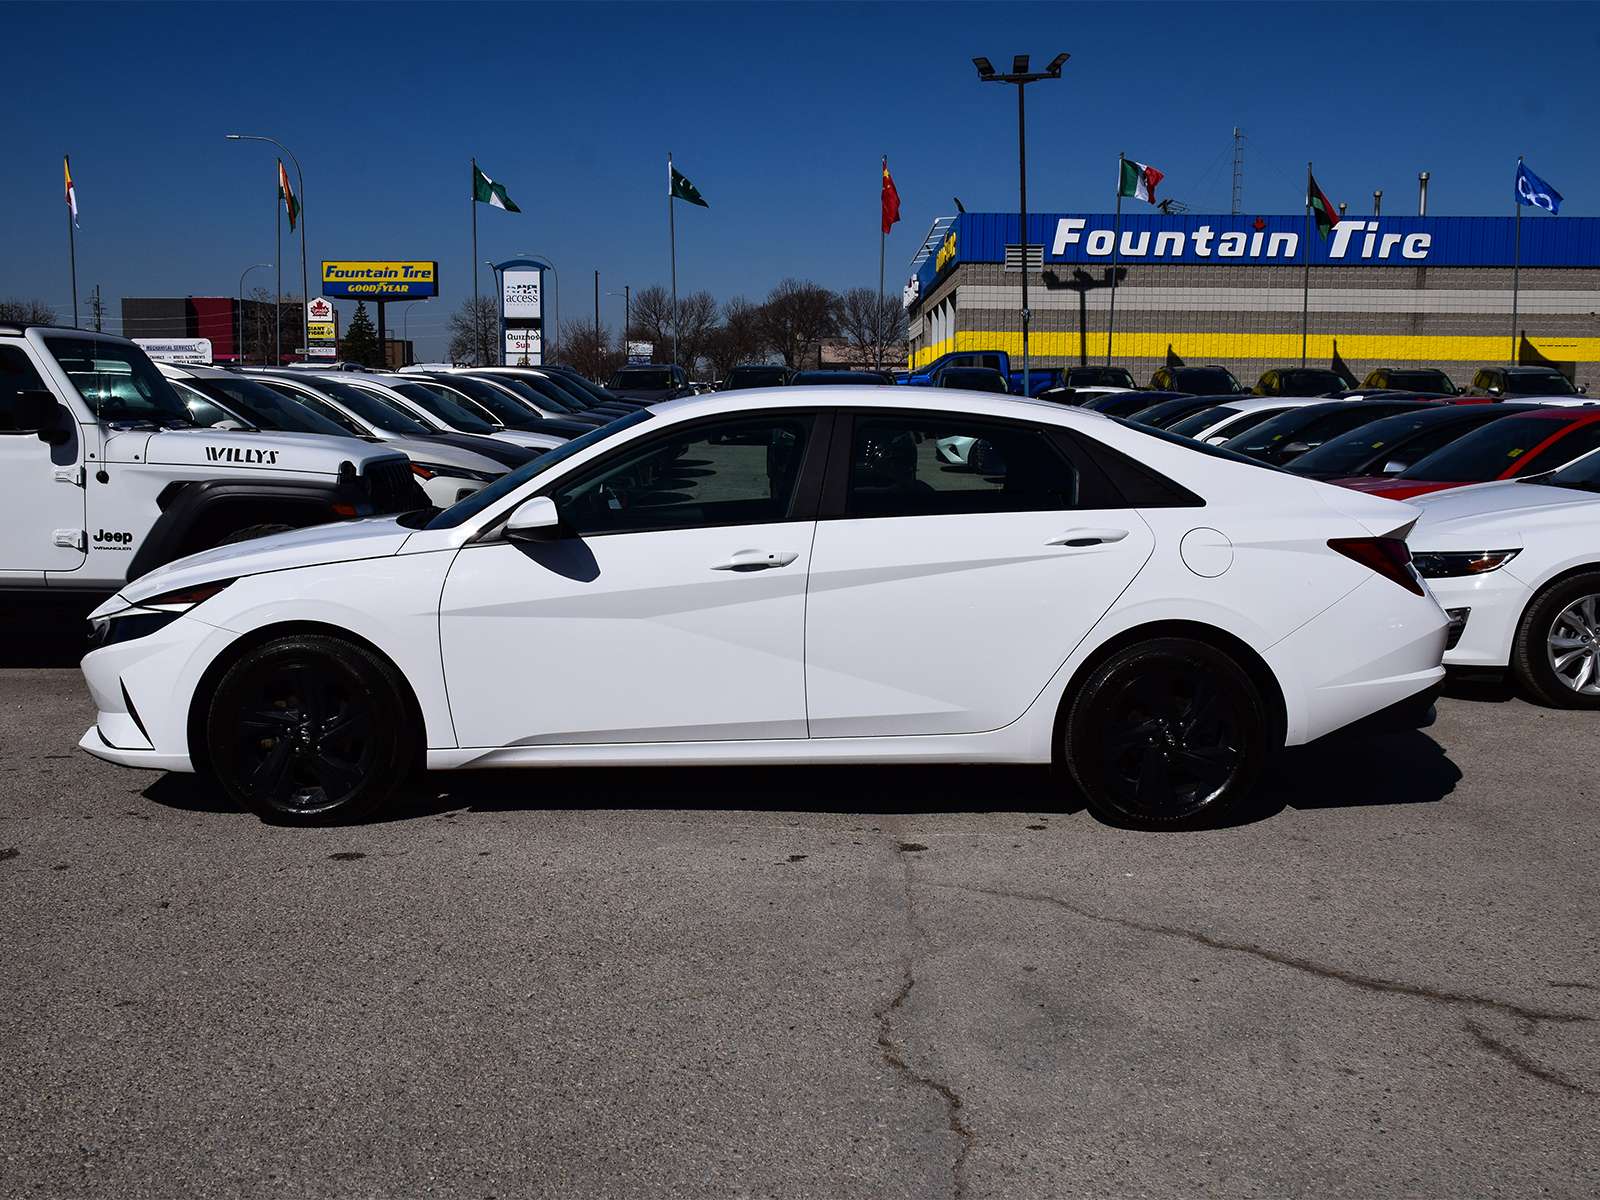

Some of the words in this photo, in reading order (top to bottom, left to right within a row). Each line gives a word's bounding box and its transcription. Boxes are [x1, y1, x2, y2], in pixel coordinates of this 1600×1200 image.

[1051, 217, 1299, 258] Fountain
[1328, 220, 1432, 259] Tire
[325, 265, 399, 278] Fountain
[401, 265, 432, 278] Tire
[347, 282, 409, 294] GOODYEAR
[506, 294, 538, 303] access
[205, 446, 279, 464] WILLYS
[93, 529, 133, 544] Jeep
